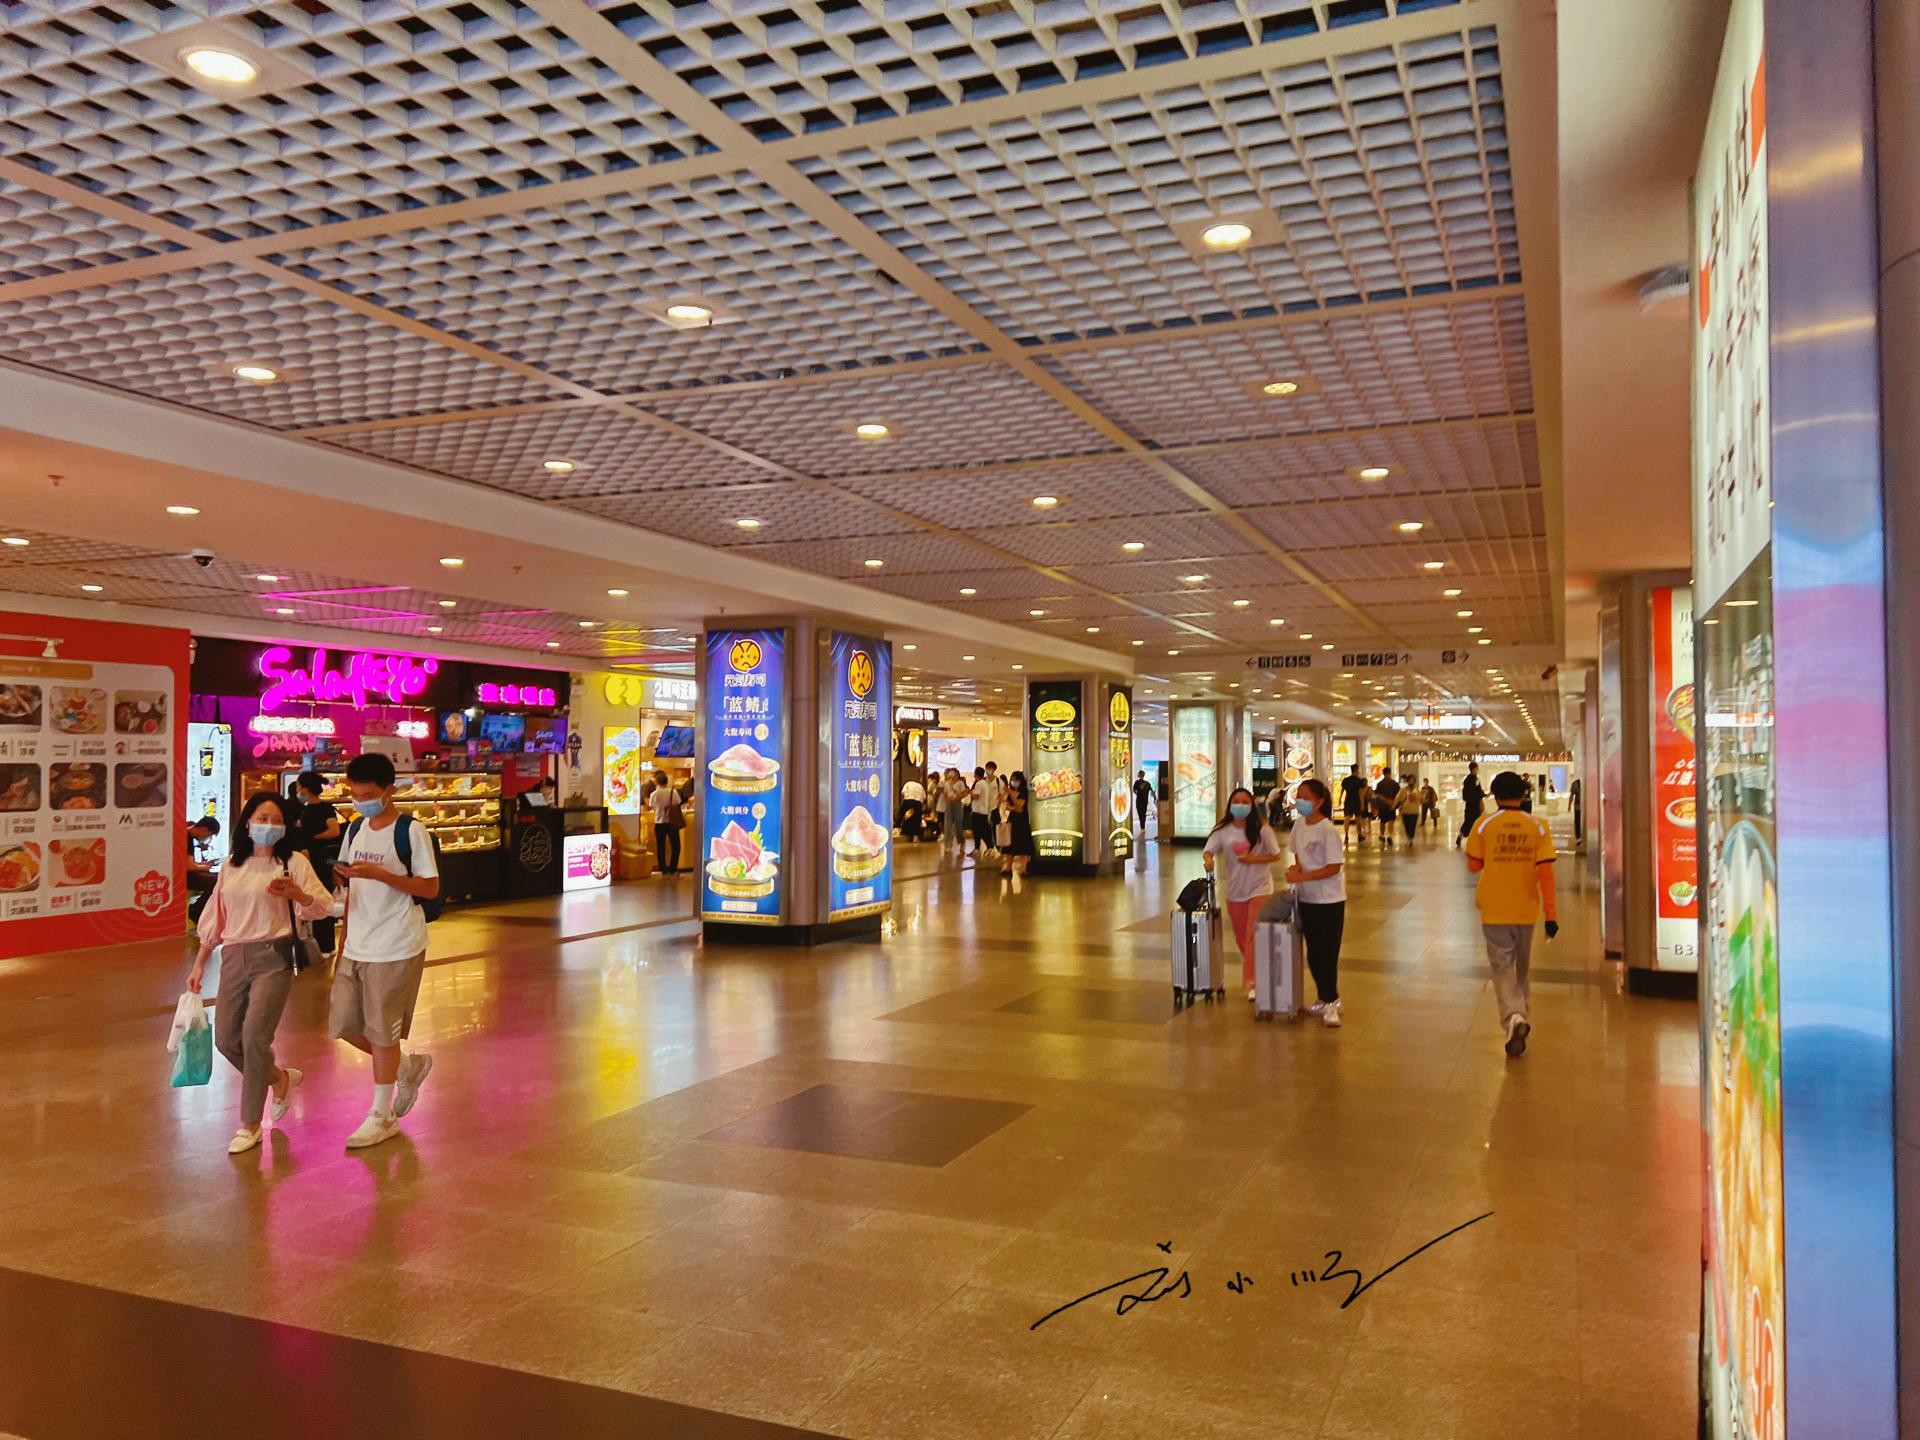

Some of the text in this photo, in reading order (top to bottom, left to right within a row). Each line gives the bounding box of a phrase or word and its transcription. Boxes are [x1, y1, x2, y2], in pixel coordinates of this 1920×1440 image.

[354, 850, 385, 861] ENERGY
[138, 879, 167, 891] NEW
[1674, 943, 1699, 957] B3
